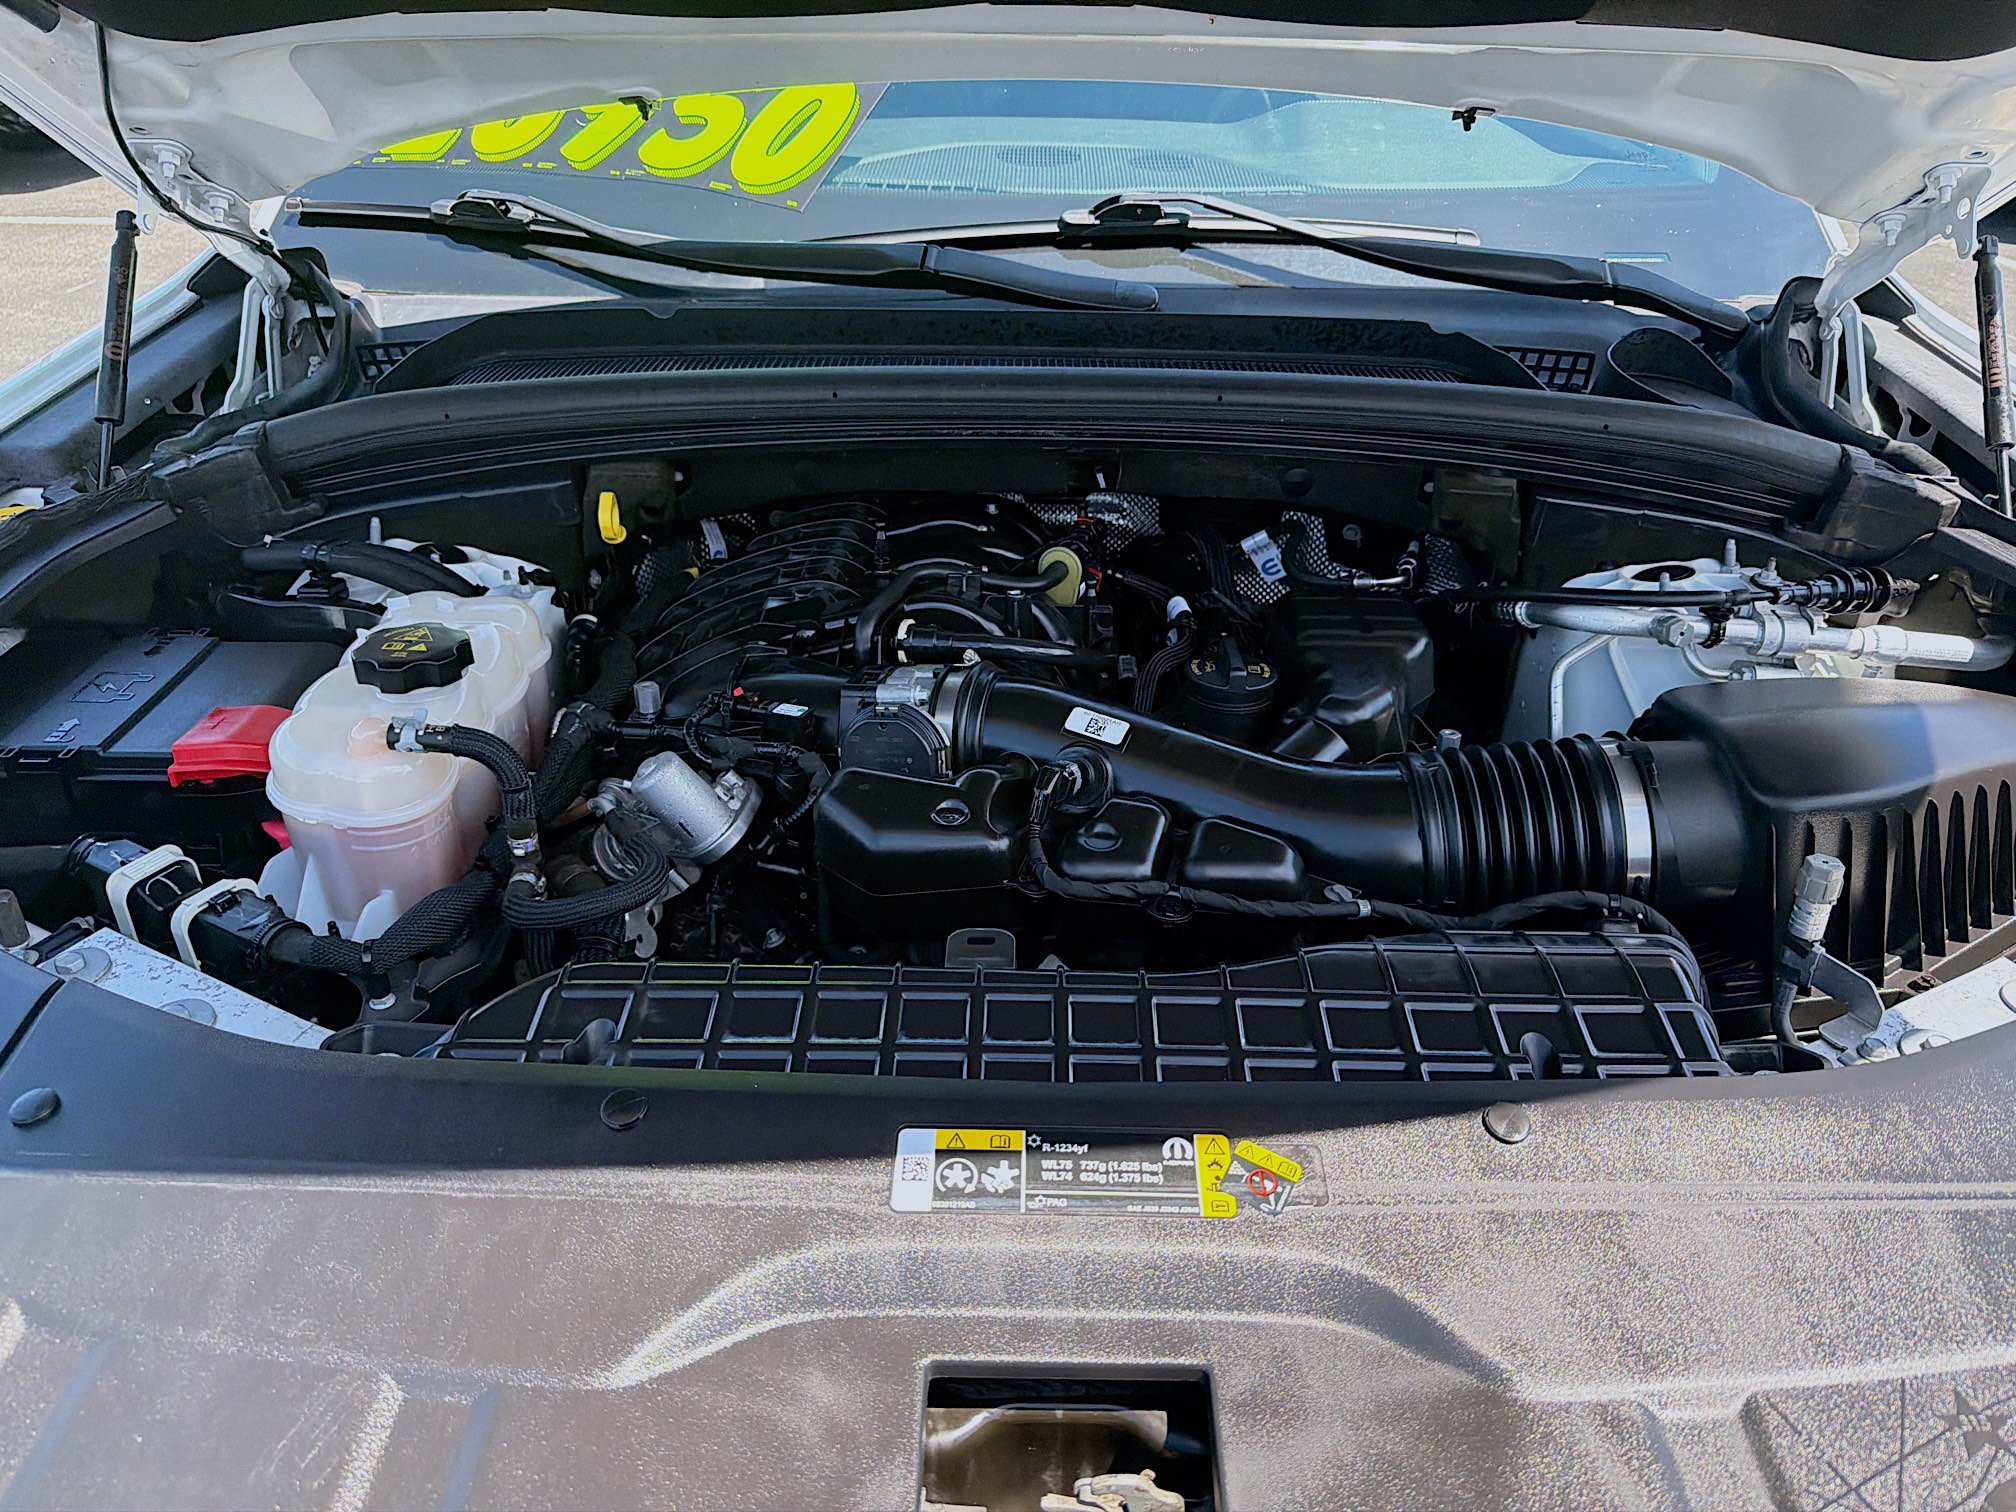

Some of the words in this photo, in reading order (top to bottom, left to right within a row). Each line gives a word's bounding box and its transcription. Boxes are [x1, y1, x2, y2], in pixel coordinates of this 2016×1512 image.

[1042, 1143, 1089, 1155] R-1234yf
[1041, 1160, 1073, 1169] WL75
[1079, 1160, 1107, 1172] 737g
[1041, 1171, 1074, 1181] WL74
[1079, 1172, 1107, 1184] 624g
[1046, 1198, 1068, 1207] PAG
